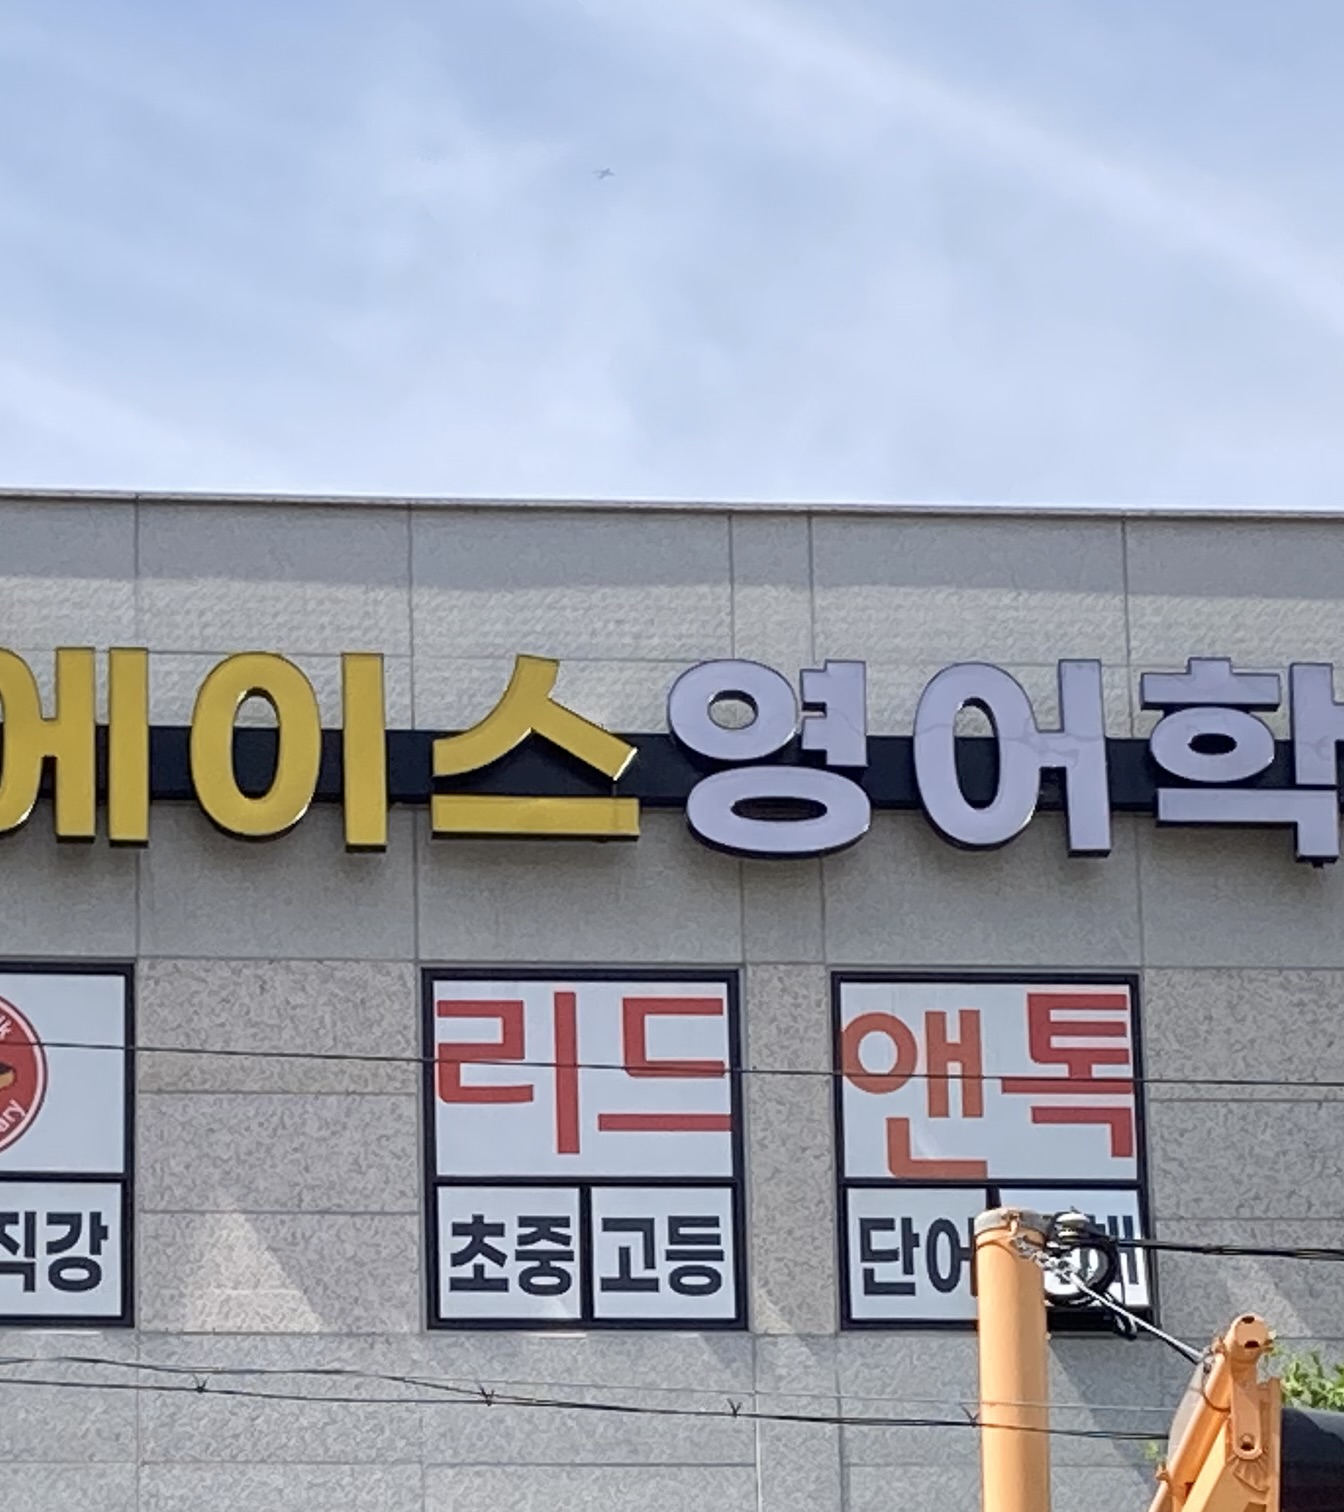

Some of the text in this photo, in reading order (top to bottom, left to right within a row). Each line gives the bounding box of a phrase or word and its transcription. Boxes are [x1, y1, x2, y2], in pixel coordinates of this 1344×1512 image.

[436, 991, 733, 1155] 리드
[841, 992, 1135, 1180] 앤톡
[449, 1213, 725, 1297] 초중 고등
